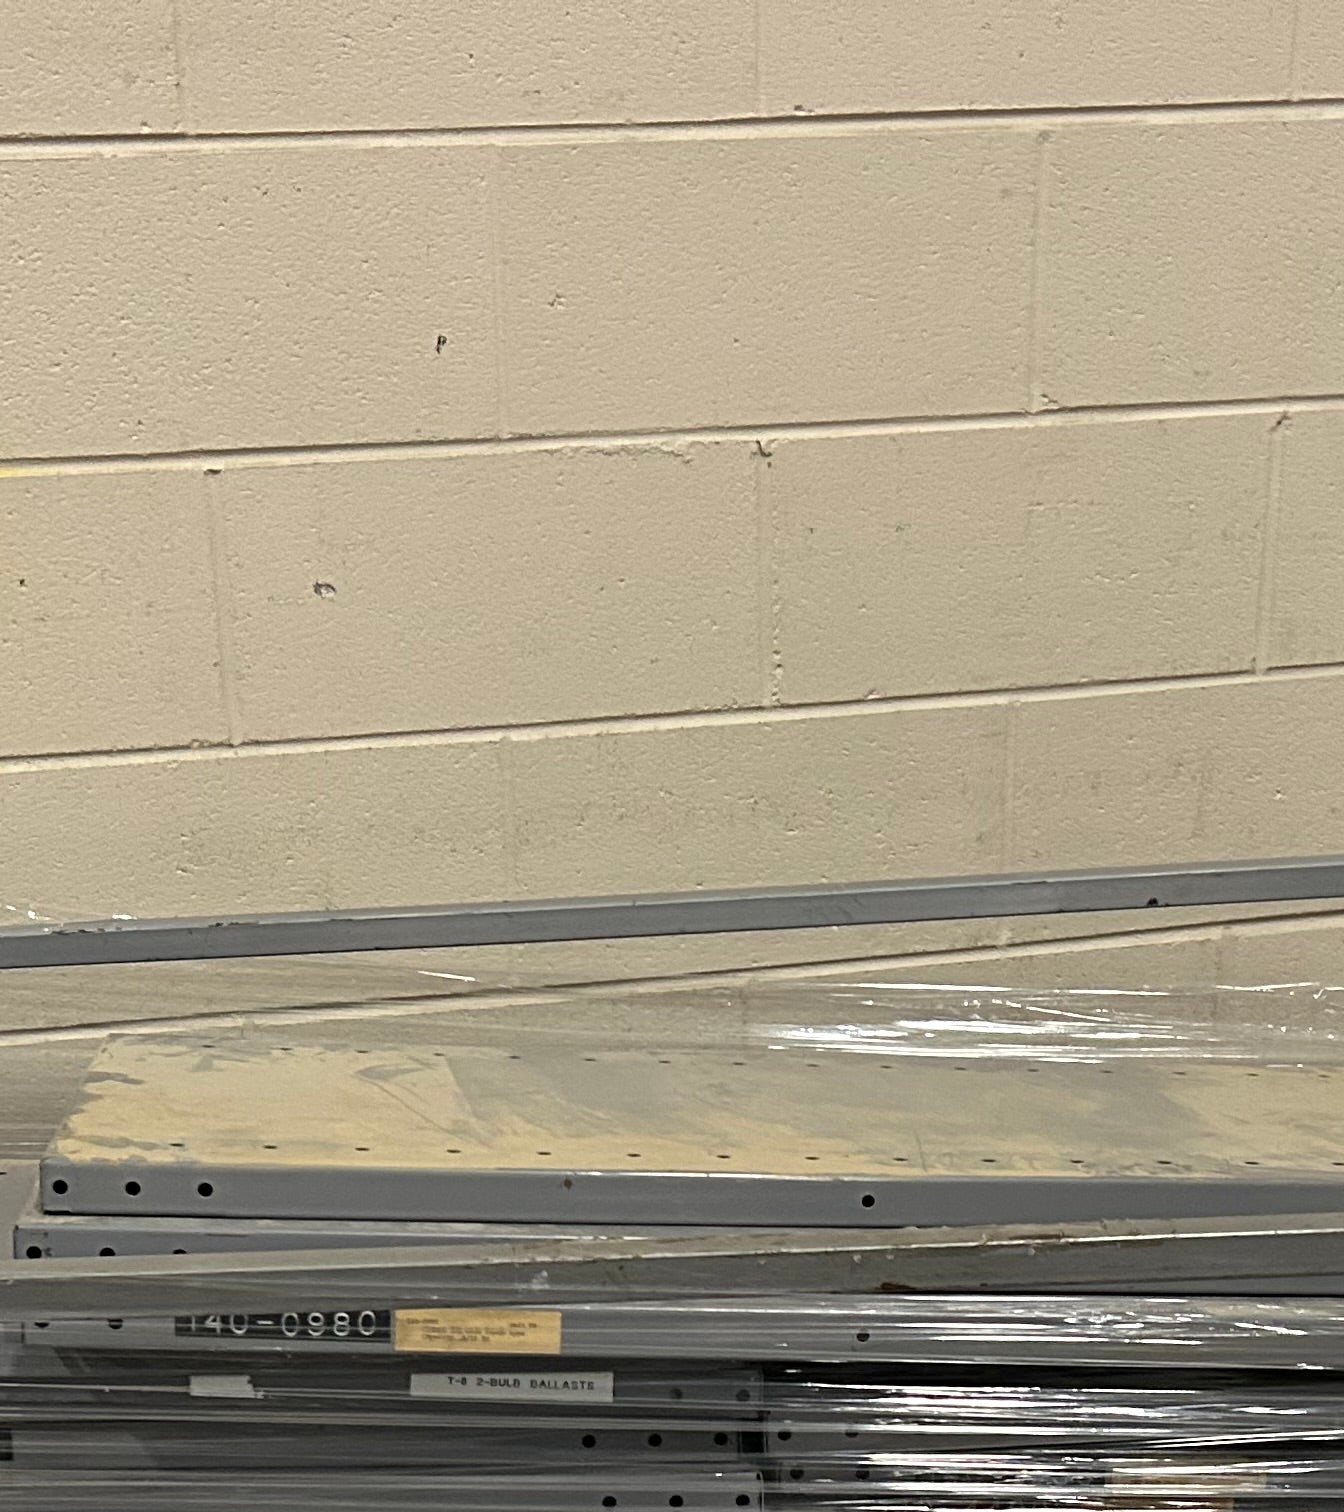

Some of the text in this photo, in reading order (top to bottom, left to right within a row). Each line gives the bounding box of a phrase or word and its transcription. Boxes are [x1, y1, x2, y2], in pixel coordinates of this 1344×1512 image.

[190, 1310, 377, 1337] 140-0980
[447, 1376, 595, 1390] T-8 2-BULB BALLASTS
